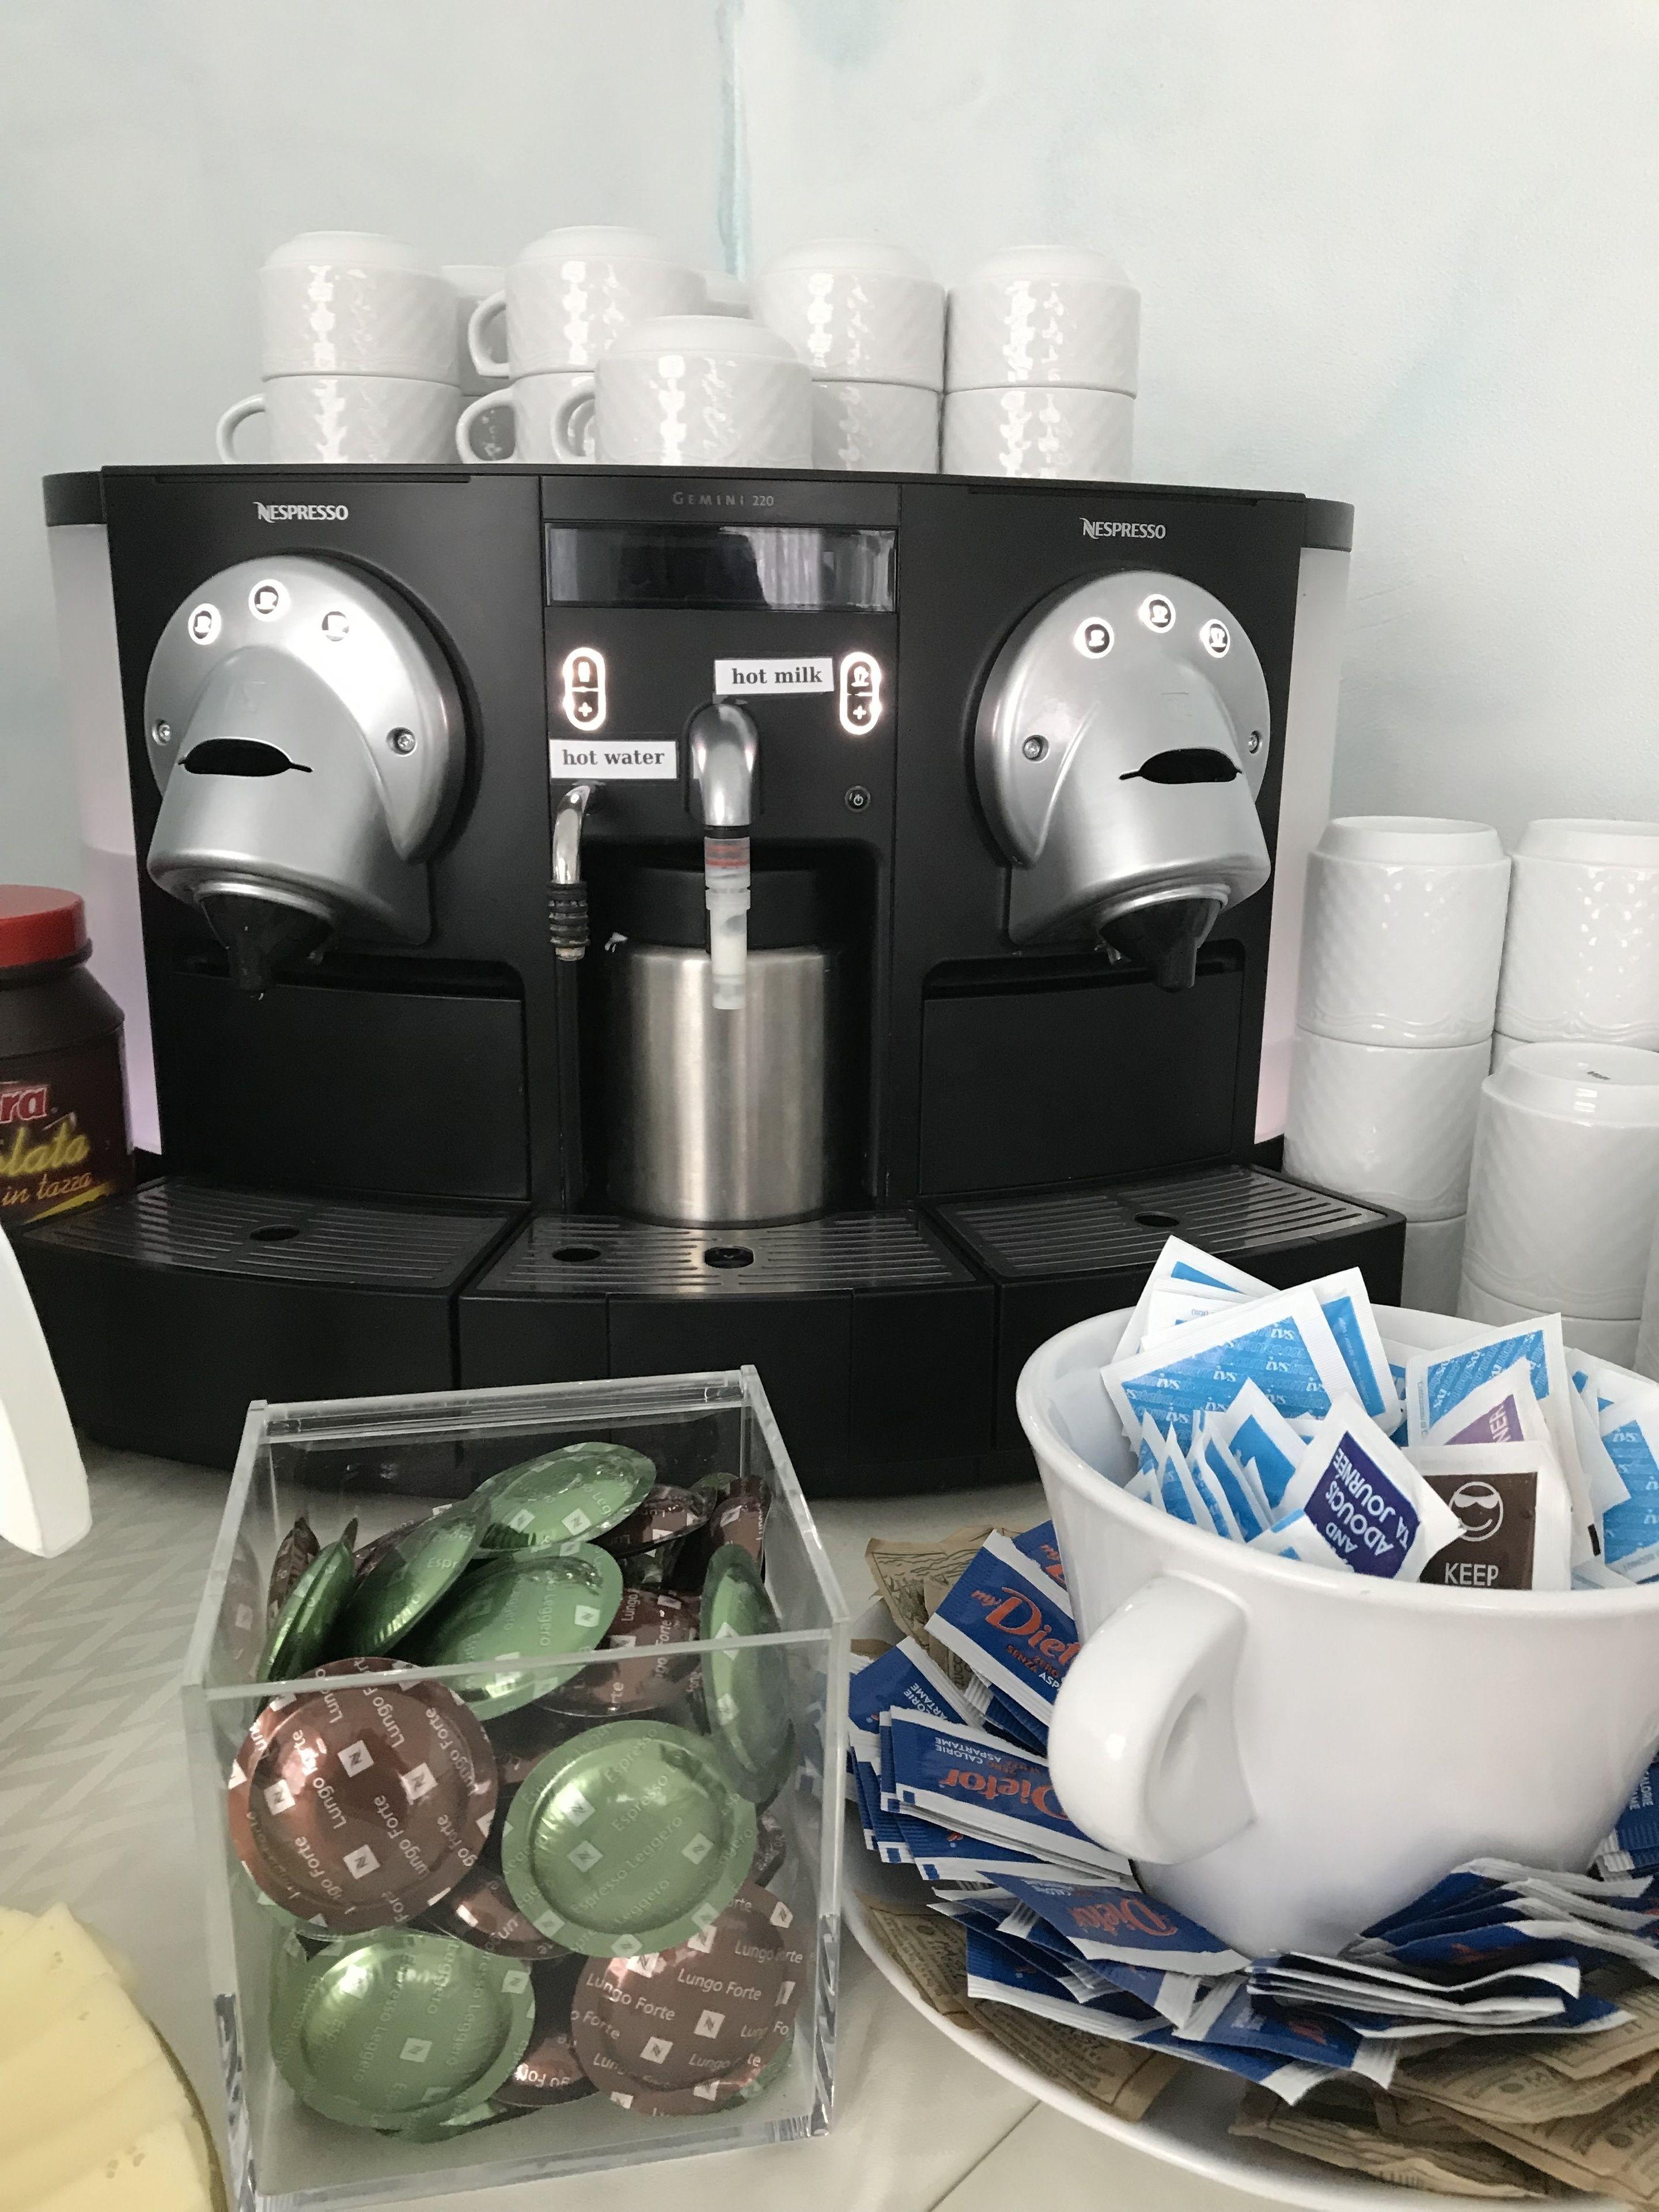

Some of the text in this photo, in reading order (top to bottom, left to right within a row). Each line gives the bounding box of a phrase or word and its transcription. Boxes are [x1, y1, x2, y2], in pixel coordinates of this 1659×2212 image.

[253, 502, 349, 523] NESPRESSO
[673, 491, 775, 507] GEMINI 220
[1080, 518, 1166, 539] NESPRESSO
[731, 666, 823, 685] hot milk
[562, 749, 665, 766] hot water
[1332, 1447, 1397, 1527] JOURNÉE
[1323, 1480, 1394, 1559] ADOUCIS
[1396, 1516, 1409, 1549] TA
[1322, 1520, 1358, 1556] AND
[1445, 1562, 1499, 1587] KEEP
[1038, 1670, 1062, 1692] ASP
[372, 1692, 406, 1748] Lungo
[423, 1705, 454, 1749] Forte
[933, 1736, 1002, 1763] ASPARTAME
[934, 1744, 984, 1765] CALORIE
[310, 1774, 347, 1830] Lungo
[370, 1792, 405, 1839] Forte
[290, 1832, 326, 1878] Forte
[626, 1813, 687, 1872] Leggero
[586, 1972, 676, 2023] Lungo Forte
[676, 1967, 763, 2002] Lungo Forte
[581, 2009, 622, 2041] Forte
